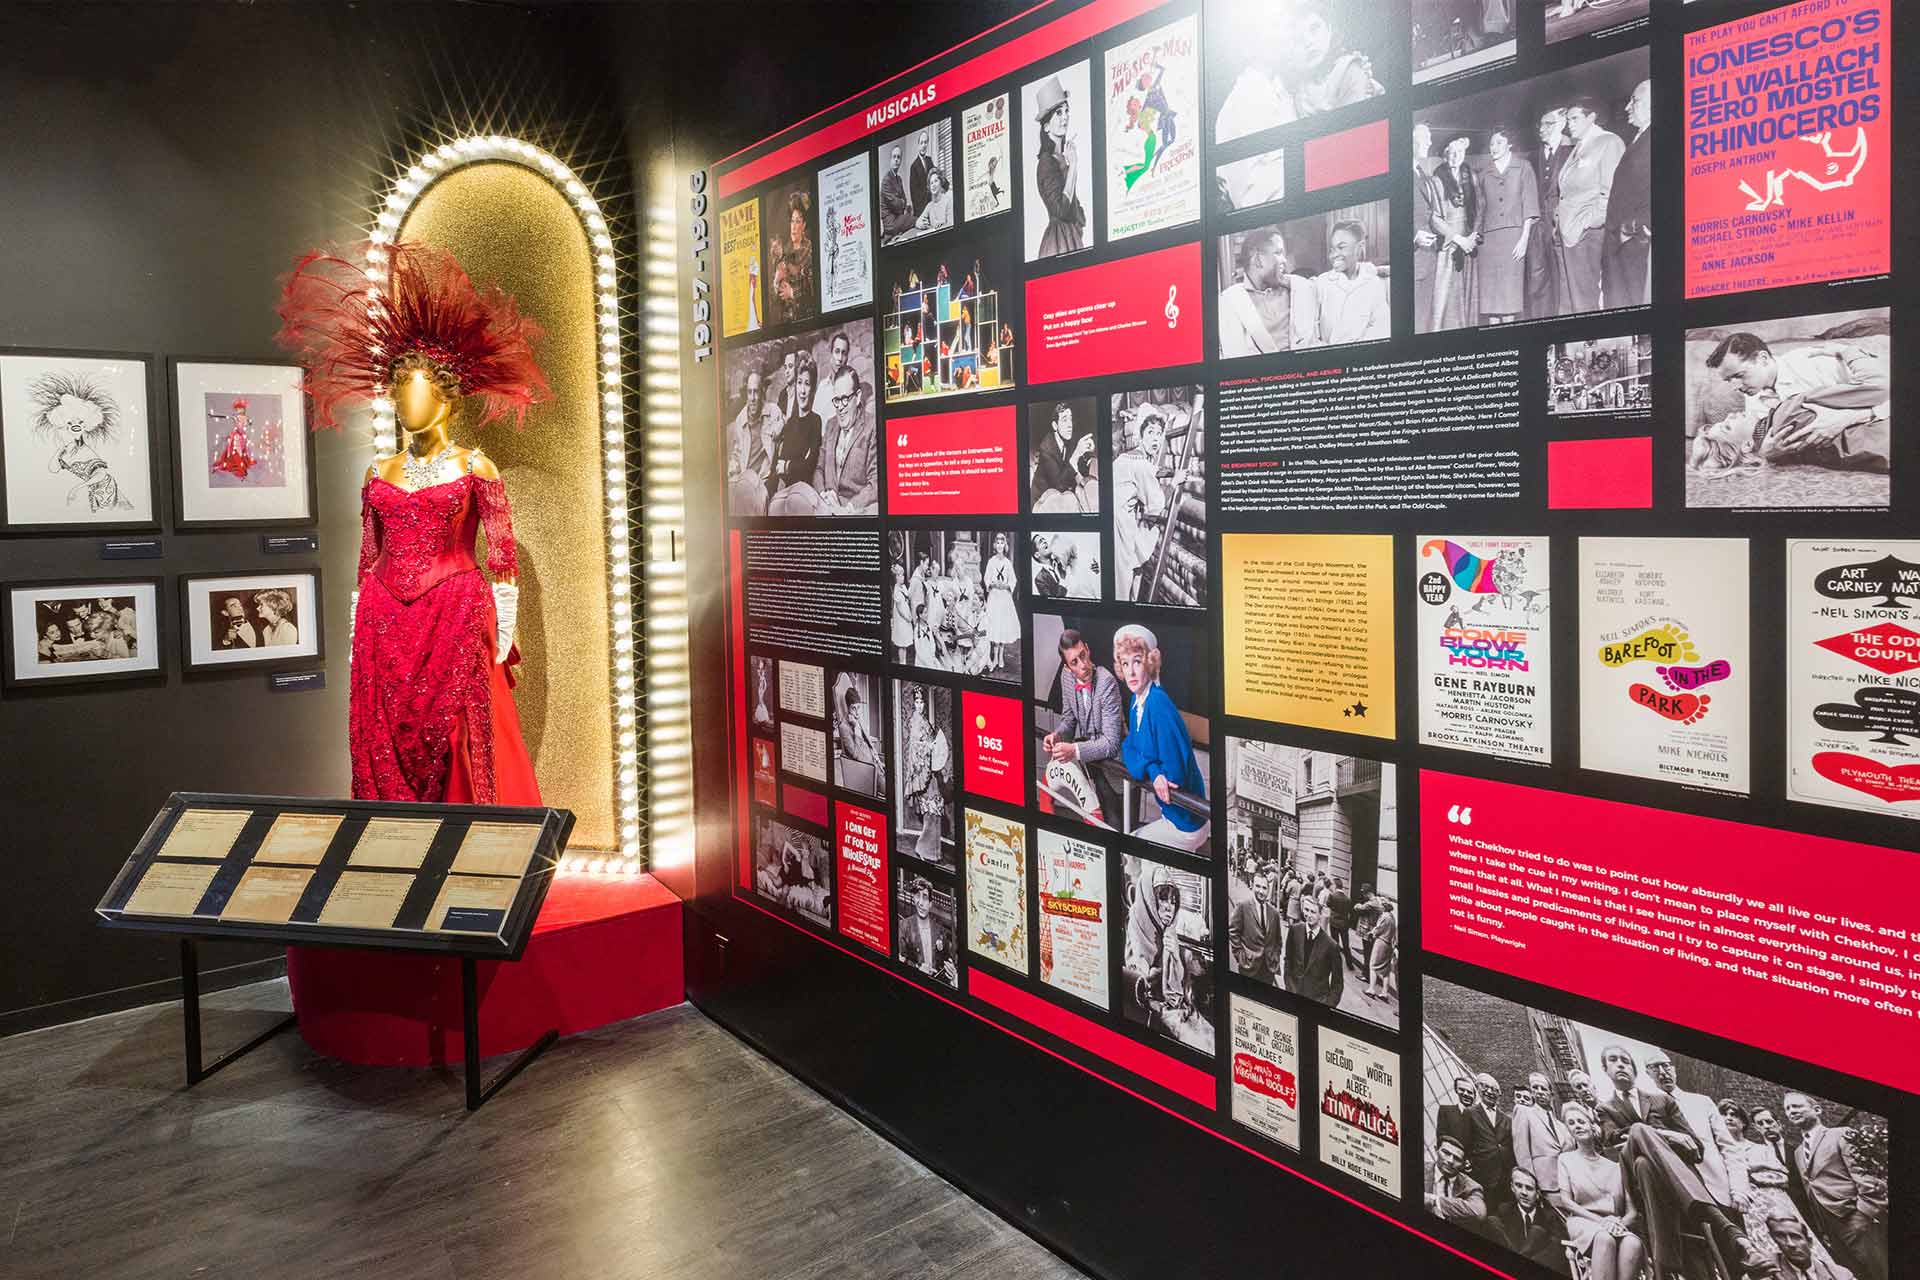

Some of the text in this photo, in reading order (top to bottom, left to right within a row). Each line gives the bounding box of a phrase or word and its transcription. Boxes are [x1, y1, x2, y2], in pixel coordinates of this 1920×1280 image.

[1690, 33, 1706, 46] THE
[1710, 27, 1733, 40] PLAY
[1737, 21, 1756, 32] YOU
[1791, 0, 1830, 18] AFFORD
[1690, 9, 1880, 78] IONESCO'S
[1690, 42, 1880, 108] ELI WALLACH
[866, 84, 936, 128] MUSICALS
[1690, 69, 1880, 129] ZERO MOSTEL
[968, 120, 1005, 143] CARNIVAL
[1690, 94, 1880, 159] RHINOCEROS
[1690, 150, 1776, 176] JOSEPH ANTHONY
[1691, 208, 1792, 233] MORRIS CARNOVSKY
[1787, 210, 1855, 230] MIKE KELLIN
[1691, 223, 1777, 245] MICHAEL STRONG
[1702, 253, 1775, 271] ANNE JACKSON
[1428, 576, 1441, 584] 2nd
[1841, 568, 1867, 578] ART
[1424, 585, 1446, 594] HAPPY
[1827, 581, 1882, 592] CARNEY
[1425, 593, 1444, 602] YEAR
[1821, 608, 1909, 620] NEIL SIMON'S
[1440, 637, 1518, 650] BLOW
[1444, 628, 1527, 644] COME
[1600, 632, 1618, 641] NEIL
[1850, 633, 1883, 645] THE
[1446, 646, 1526, 662] YOUR
[1604, 636, 1677, 664] BAREFOOT
[1855, 647, 1920, 662] COUPL
[1449, 655, 1529, 672] HORN
[1674, 663, 1723, 684] IN THE
[1858, 674, 1891, 685] MIKE
[1434, 676, 1535, 696] GENE RAYBURN
[1448, 690, 1531, 704] HENRIETTA JACOBSON
[1453, 698, 1515, 710] MARTIN HUSTON
[1639, 688, 1684, 714] PARK
[1441, 711, 1533, 728] MORRIS CARNOVSKY
[977, 734, 1002, 751] 1963
[1428, 732, 1544, 754] BROOKS ATKINSON THEATRE
[1658, 745, 1728, 762] MIKE NICHOLS
[1659, 764, 1729, 778] BILTMORE THEATRE
[1841, 768, 1892, 781] PLYMOUTH
[1050, 768, 1087, 807] CORONIA
[850, 822, 862, 835] CAN
[864, 826, 876, 838] GET
[845, 834, 877, 853] IT FOR YOU
[842, 846, 880, 869] WHOLESALE
[980, 852, 1009, 870] Camelot
[1448, 834, 1473, 846] What
[1474, 840, 1516, 855] Chekhov
[1517, 849, 1541, 861] tried
[1543, 855, 1554, 863] to
[1556, 858, 1570, 867] do
[1572, 862, 1593, 872] was
[1595, 866, 1607, 875] to
[1610, 870, 1639, 882] point
[1641, 877, 1661, 886] out
[1664, 880, 1689, 892] how
[1691, 887, 1744, 906] absurdly
[1746, 899, 1765, 909] we
[1768, 903, 1784, 913] all
[1788, 906, 1810, 918] live
[1813, 914, 1837, 924] our
[1878, 927, 1906, 939] and
[1047, 900, 1097, 917] SKYSCRAPER
[1449, 850, 1477, 862] where
[1485, 858, 1506, 868] take
[1509, 863, 1525, 872] the
[1527, 868, 1546, 877] cue
[1549, 871, 1559, 880] in
[1561, 875, 1578, 886] my
[1580, 880, 1621, 895] writing.
[1624, 888, 1628, 896] I
[1631, 890, 1660, 903] don't
[1664, 898, 1697, 911] mean
[1700, 905, 1713, 914] to
[1717, 910, 1750, 923] place
[1754, 918, 1796, 933] myself
[1799, 928, 1830, 941] with
[1834, 935, 1898, 957] Chekhov.
[1904, 950, 1908, 959] I
[1449, 865, 1475, 876] mean
[1476, 870, 1496, 881] that
[1498, 876, 1508, 884] at
[1510, 878, 1524, 888] all.
[1526, 881, 1553, 894] What
[1555, 888, 1559, 896] I
[1561, 891, 1591, 903] mean
[1593, 896, 1602, 906] is
[1604, 900, 1627, 912] that
[1629, 905, 1633, 913] I
[1636, 908, 1655, 918] see
[1657, 911, 1696, 927] humor
[1699, 921, 1710, 931] in
[1713, 926, 1755, 942] almost
[1758, 937, 1827, 960] everything
[1830, 953, 1880, 971] around
[1449, 880, 1473, 890] small
[1476, 884, 1509, 899] hassles
[1511, 894, 1530, 904] and
[1532, 899, 1602, 922] predicaments
[1604, 917, 1616, 925] of
[1653, 929, 1675, 940] and
[1679, 933, 1683, 941] I
[1686, 935, 1702, 947] try
[1705, 940, 1718, 950] to
[1721, 945, 1769, 962] capture
[1773, 955, 1782, 966] it
[1785, 961, 1803, 971] on
[1806, 966, 1846, 981] stage.
[1850, 974, 1855, 983] I
[1859, 978, 1907, 998] simply
[1325, 1051, 1353, 1072] GIELGUD
[1366, 1067, 1392, 1087] WORTH
[1327, 1098, 1393, 1139] TINY ALICE
